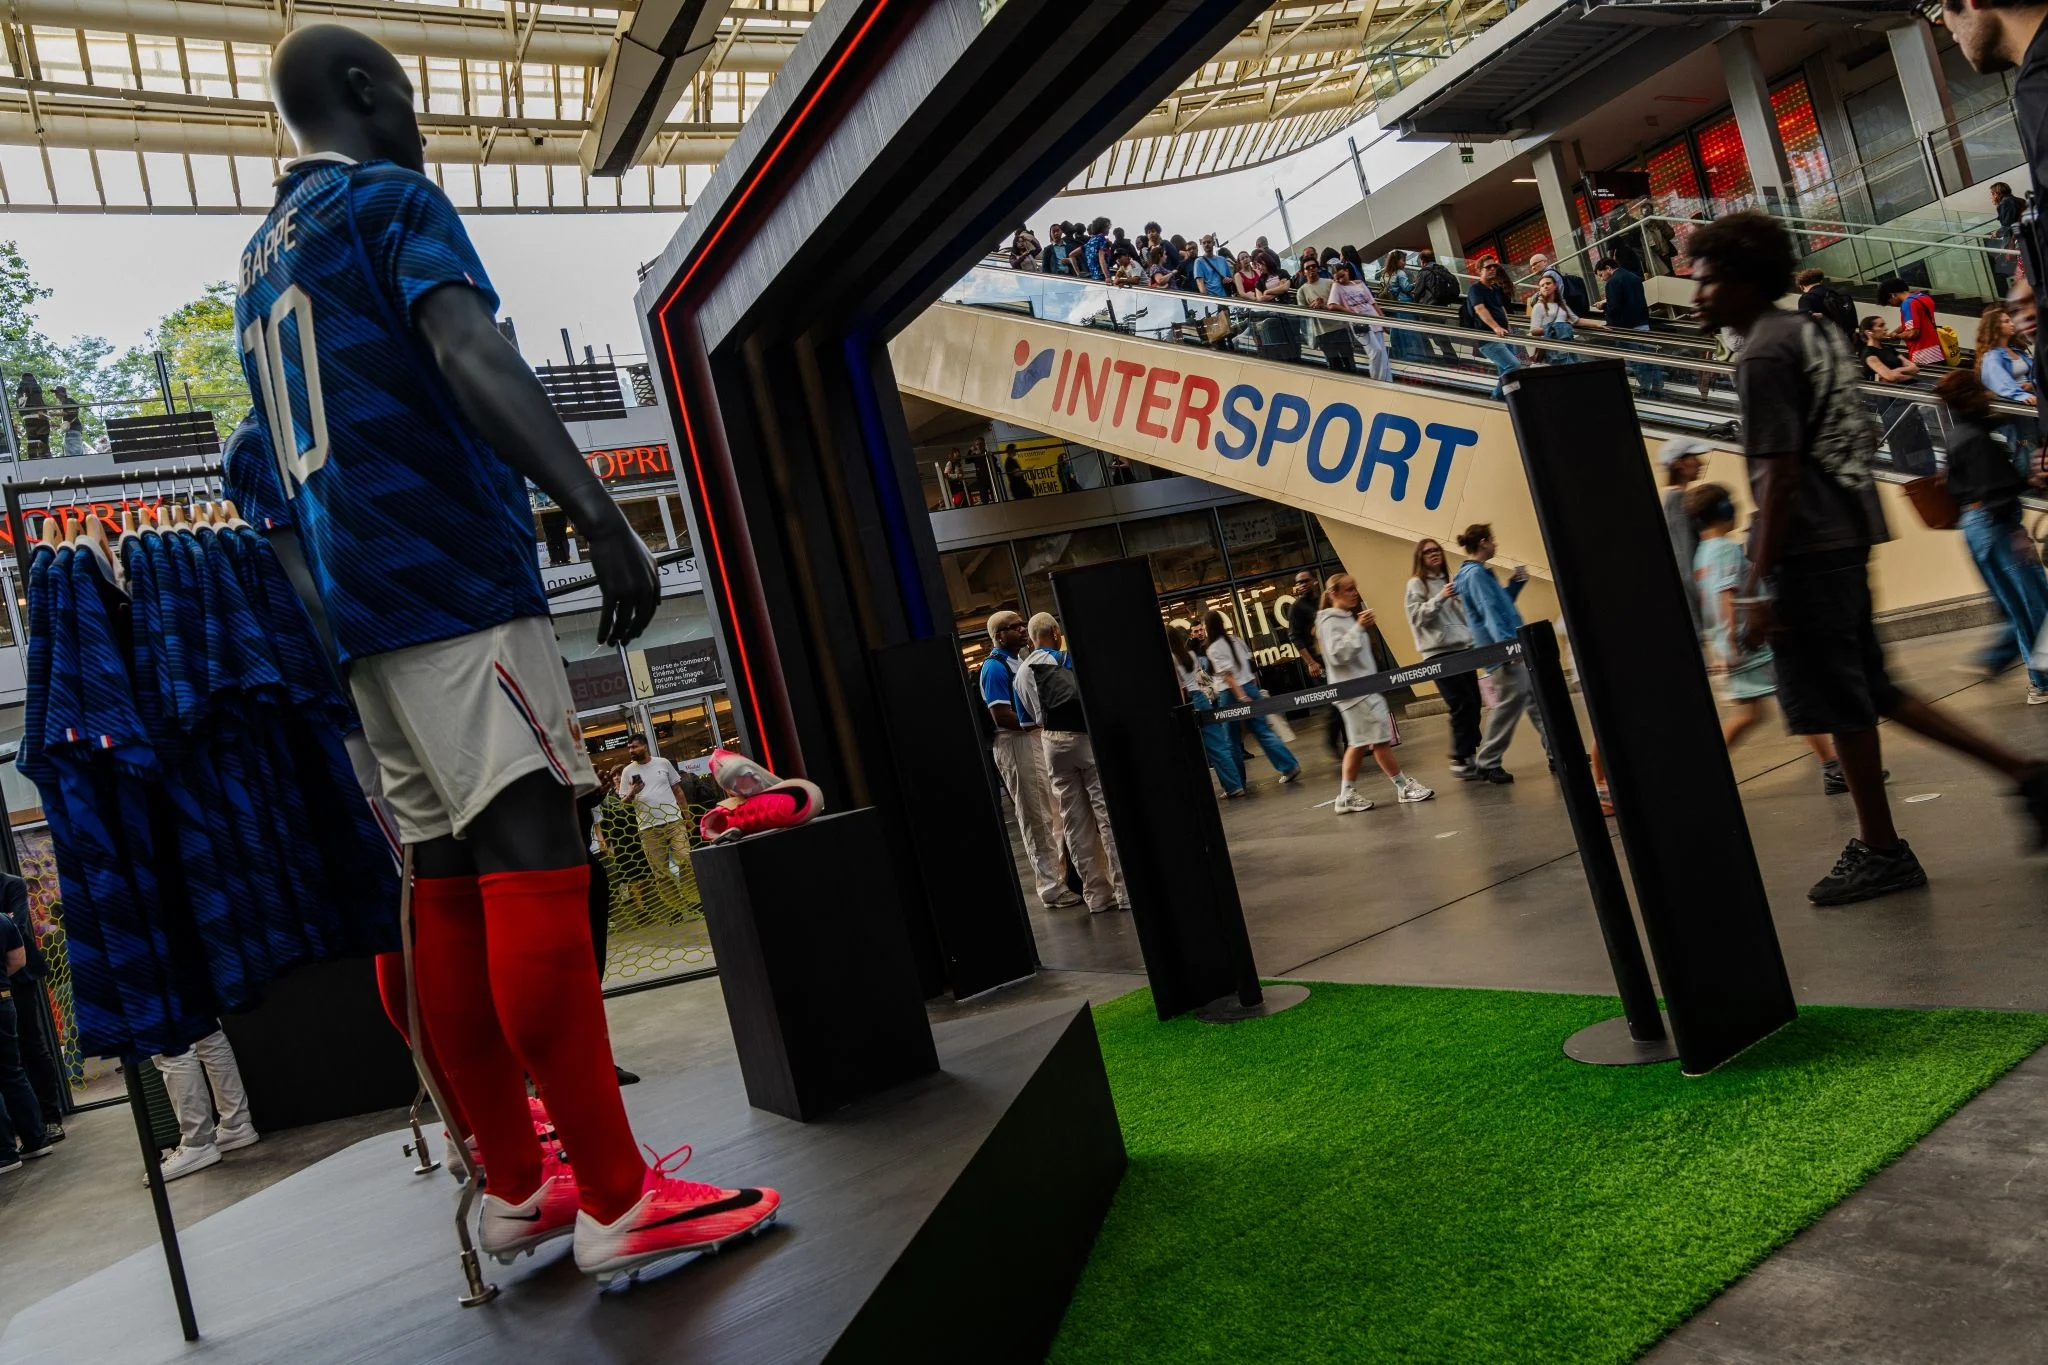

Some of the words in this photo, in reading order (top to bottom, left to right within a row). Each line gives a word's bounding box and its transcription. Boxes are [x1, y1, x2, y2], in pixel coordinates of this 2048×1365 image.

[243, 283, 330, 500] 10
[1051, 349, 1478, 511] INTERSPORT
[586, 442, 673, 480] OPRI
[651, 664, 673, 672] Bourse
[679, 656, 710, 667] Commerce
[652, 669, 675, 678] Cinéma
[676, 666, 688, 674] UGC
[654, 676, 674, 684] Forum
[682, 670, 705, 678] Images
[1396, 663, 1442, 683] INTERSPORT
[656, 681, 677, 690] Piscine
[1300, 688, 1338, 704] INTERSPORT
[1219, 705, 1251, 719] INTERSPORT
